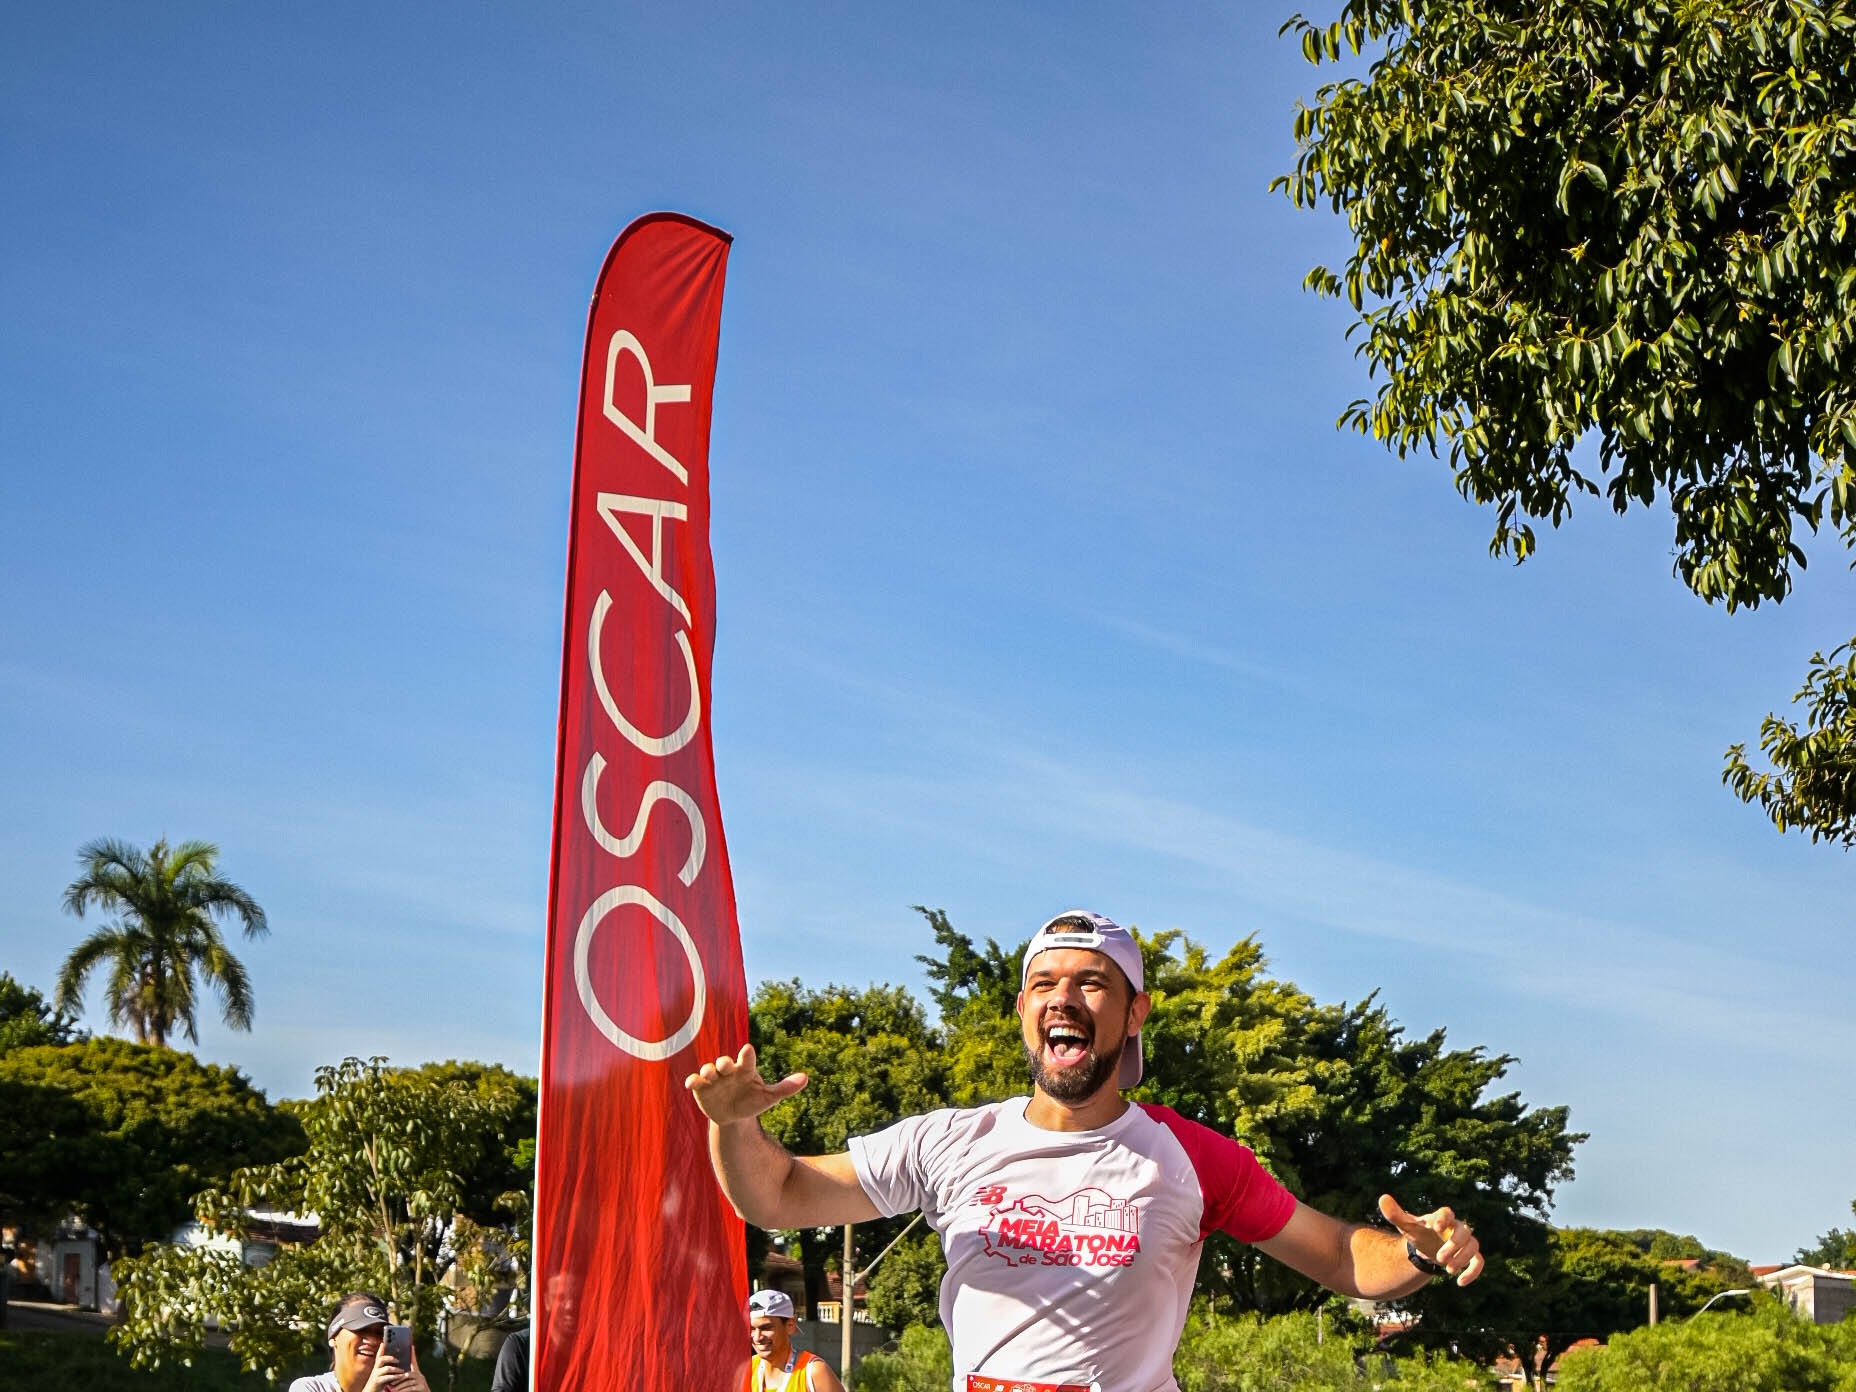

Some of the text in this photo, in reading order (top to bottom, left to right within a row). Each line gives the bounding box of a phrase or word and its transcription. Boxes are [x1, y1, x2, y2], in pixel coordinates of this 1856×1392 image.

[573, 328, 708, 1062] OSCAR
[998, 1218, 1060, 1237] MEIA
[997, 1231, 1141, 1253] MARATONA
[1018, 1248, 1134, 1267] de São José
[972, 1381, 991, 1390] OSCAR
